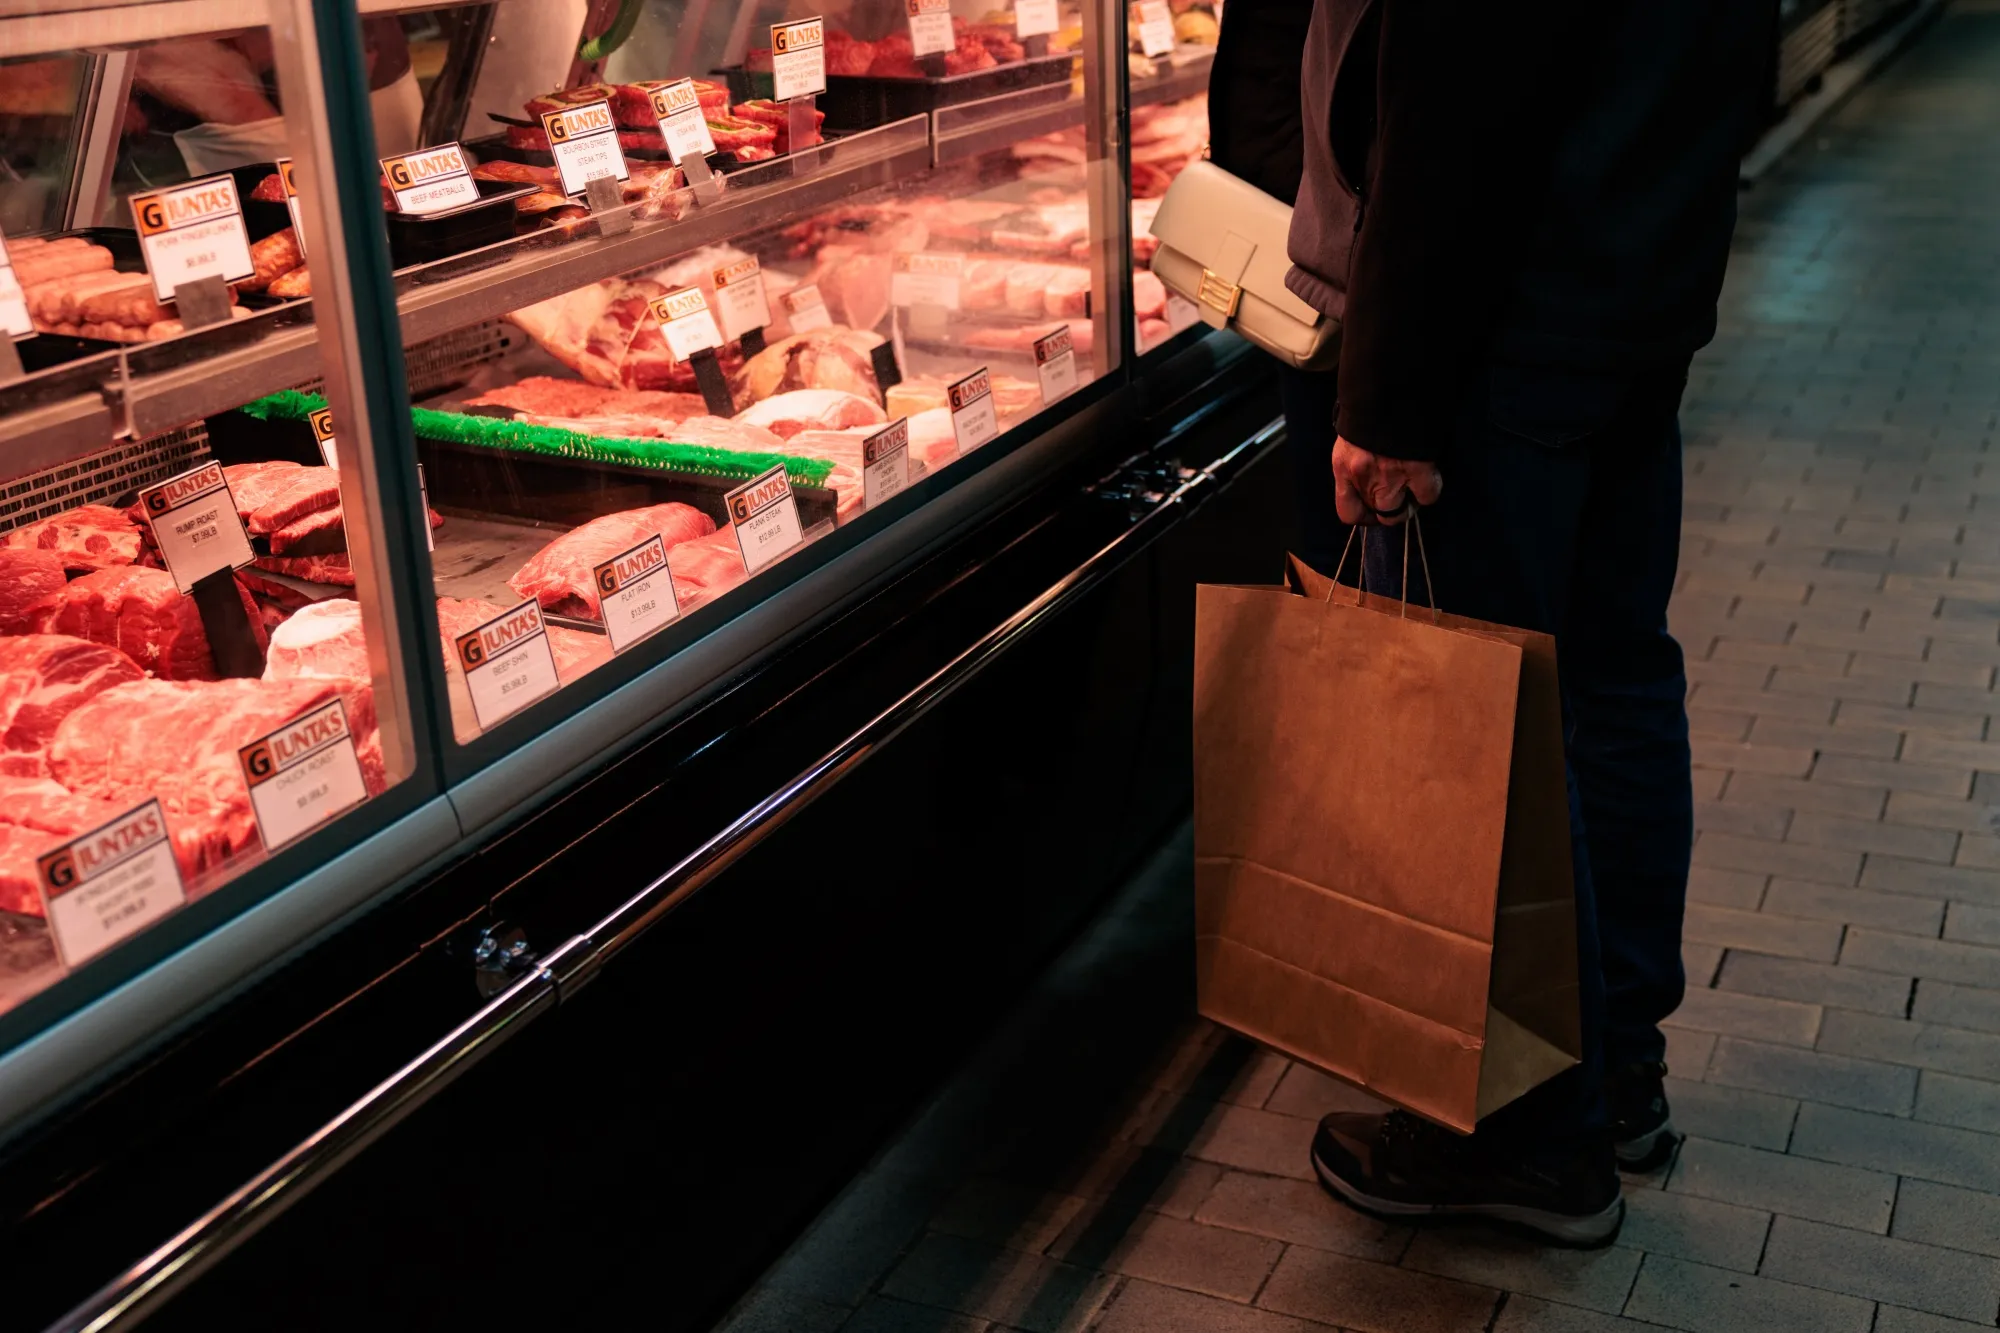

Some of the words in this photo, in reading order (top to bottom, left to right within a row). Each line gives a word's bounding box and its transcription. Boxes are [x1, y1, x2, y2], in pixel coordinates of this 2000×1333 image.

[776, 25, 820, 50] GIUNTA'S
[654, 86, 696, 114] GIUNTA'S
[550, 108, 609, 139] GIUNTA'S
[563, 143, 590, 155] BOURBON
[590, 137, 609, 149] STREET
[578, 156, 595, 167] STEAK
[596, 151, 608, 161] TIPS
[391, 151, 462, 185] GIUNTA'S
[143, 187, 232, 229] GIUNTA'S
[410, 193, 428, 205] BEEF
[429, 183, 466, 199] MEATBALLS
[656, 291, 704, 320] GIUNTA'S
[1037, 333, 1070, 361] GIUNTA'S
[951, 375, 988, 408] GIUNTA'S
[865, 425, 906, 462] GIUNTA'S
[148, 468, 220, 510] GIUNTA'S
[734, 475, 788, 519] GIUNTA'S
[176, 521, 196, 535] RUMP
[196, 510, 219, 525] ROAST
[749, 516, 766, 531] FLANK
[766, 506, 783, 523] STEAK
[191, 526, 218, 543] $7.99LB
[600, 544, 663, 592] GIUNTA'S
[621, 588, 636, 603] FLAT
[636, 580, 652, 595] IRON
[630, 599, 656, 619] $13.99LB
[464, 609, 540, 664] GIUNTA'S
[492, 660, 511, 677] BEEF
[511, 650, 529, 668] SHIN
[248, 710, 343, 777] GIUNTA'S
[276, 768, 307, 791] CHUCK
[307, 750, 336, 772] ROAST
[48, 811, 160, 888] GIUNTA'S
